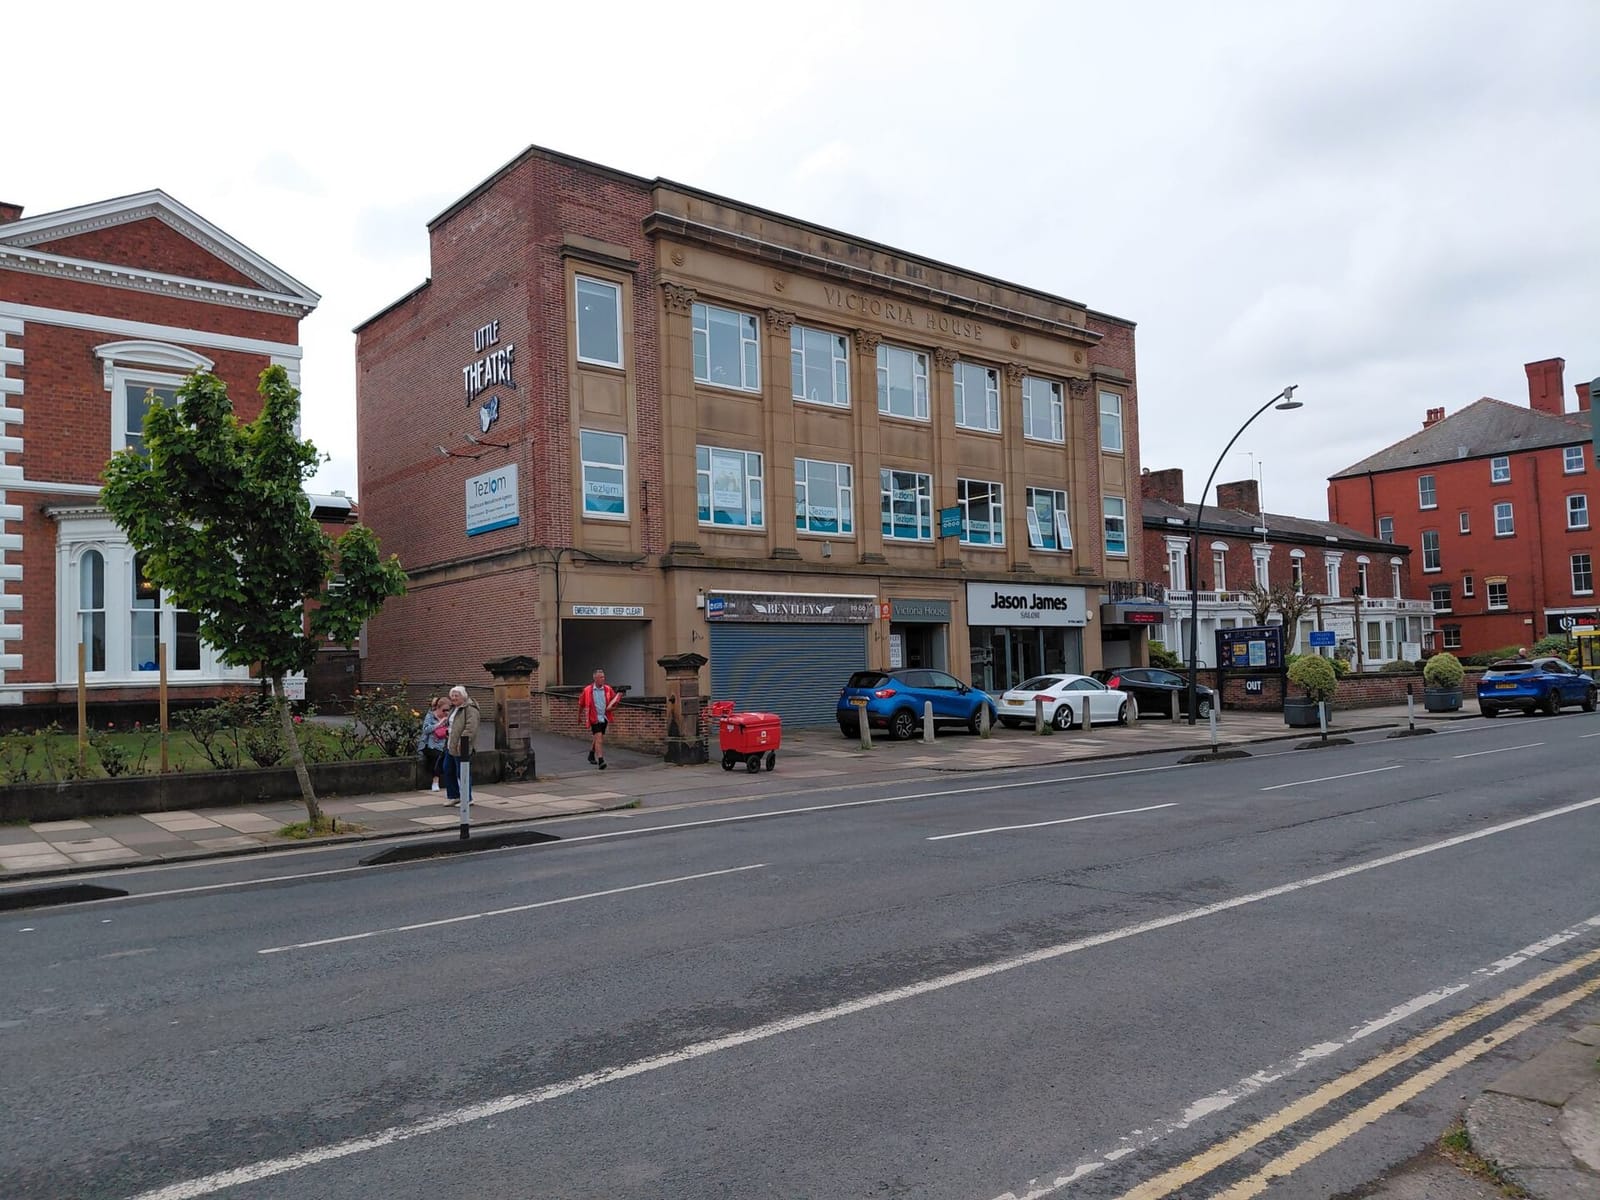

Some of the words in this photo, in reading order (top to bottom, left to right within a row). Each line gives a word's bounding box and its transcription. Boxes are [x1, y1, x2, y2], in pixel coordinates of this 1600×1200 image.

[823, 286, 914, 325] VICTORIA
[926, 312, 983, 341] HOUSE
[473, 319, 499, 353] LITTLE
[462, 343, 515, 397] THEATRE
[473, 476, 507, 496] Tezlom
[767, 603, 822, 616] BENTLEYS
[991, 592, 1027, 609] Jason
[1029, 593, 1067, 611] James
[613, 607, 624, 615] KEEP
[626, 607, 641, 616] CLEAR
[1246, 680, 1262, 691] OUT
